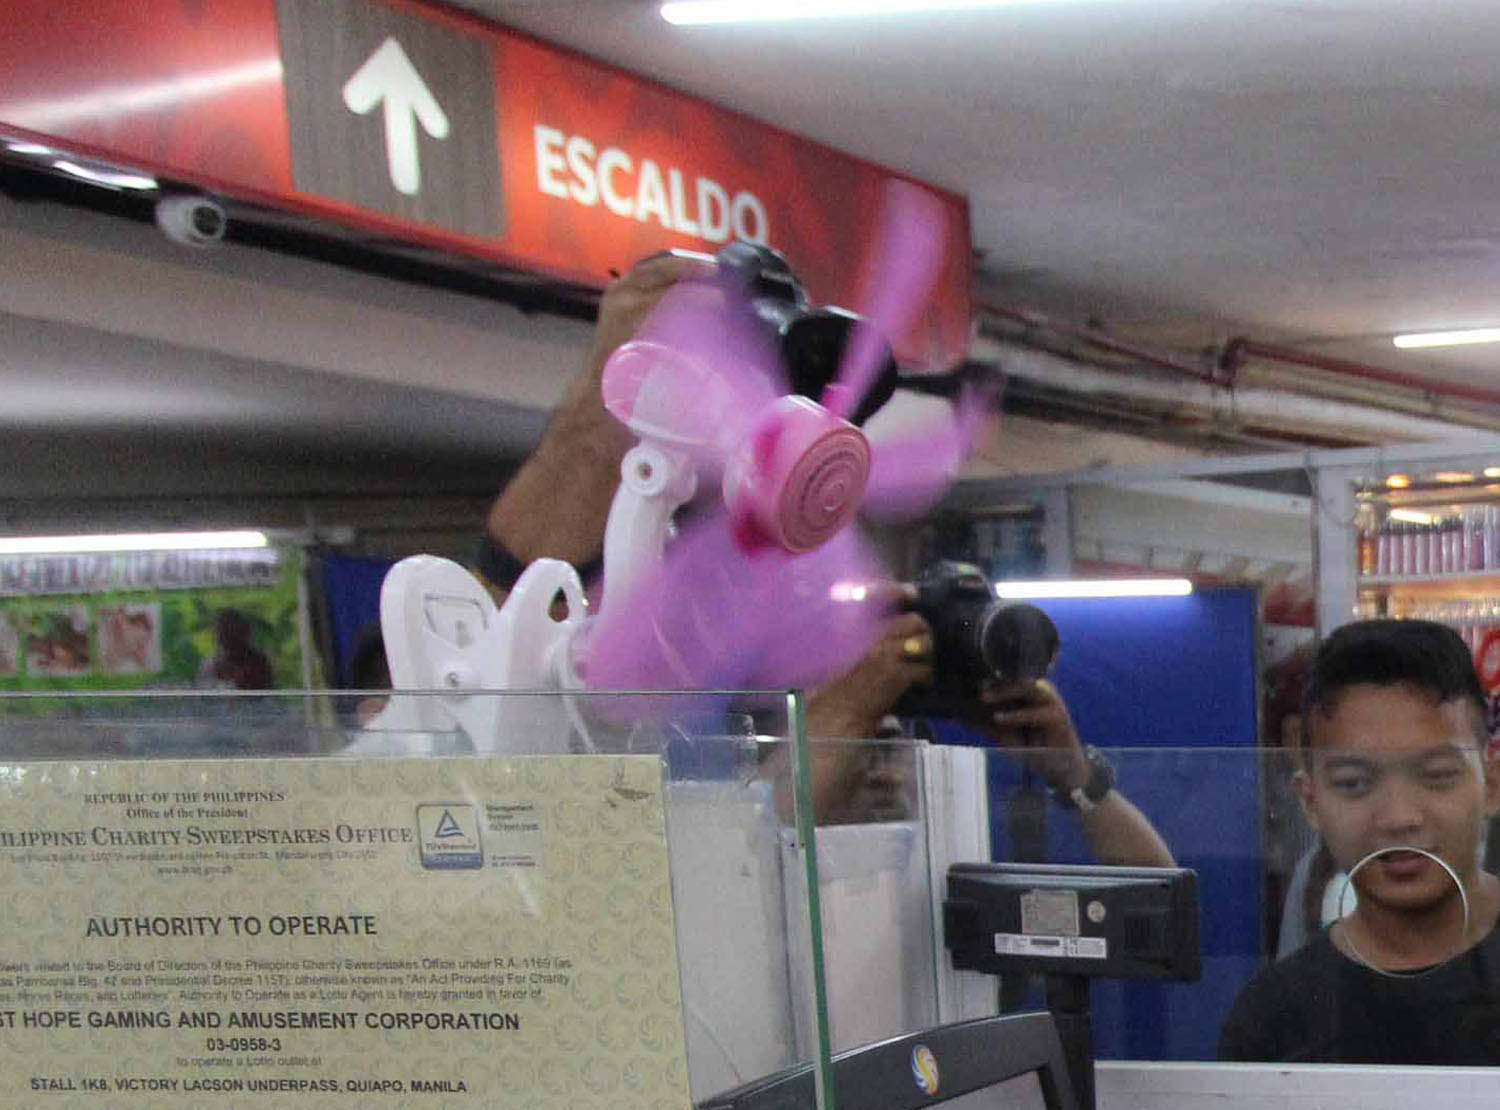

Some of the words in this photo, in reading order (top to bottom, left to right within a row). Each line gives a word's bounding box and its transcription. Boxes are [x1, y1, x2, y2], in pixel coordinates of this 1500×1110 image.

[534, 124, 769, 247] ESCALDO
[86, 917, 222, 938] AUTHORITY
[227, 917, 262, 937] TO
[269, 915, 378, 936] OPERATE
[23, 1012, 82, 1029] HOPE
[88, 1012, 171, 1029] GAMING
[178, 1012, 221, 1029] AND
[228, 1012, 359, 1030] AMUSEMENT
[365, 1012, 520, 1031] CORPORATION
[207, 1038, 282, 1052] 03-0958-3
[31, 1078, 76, 1091] STALL
[115, 1078, 178, 1091] VICTORY
[184, 1079, 243, 1092] LACSON
[410, 1080, 467, 1092] MANILA
